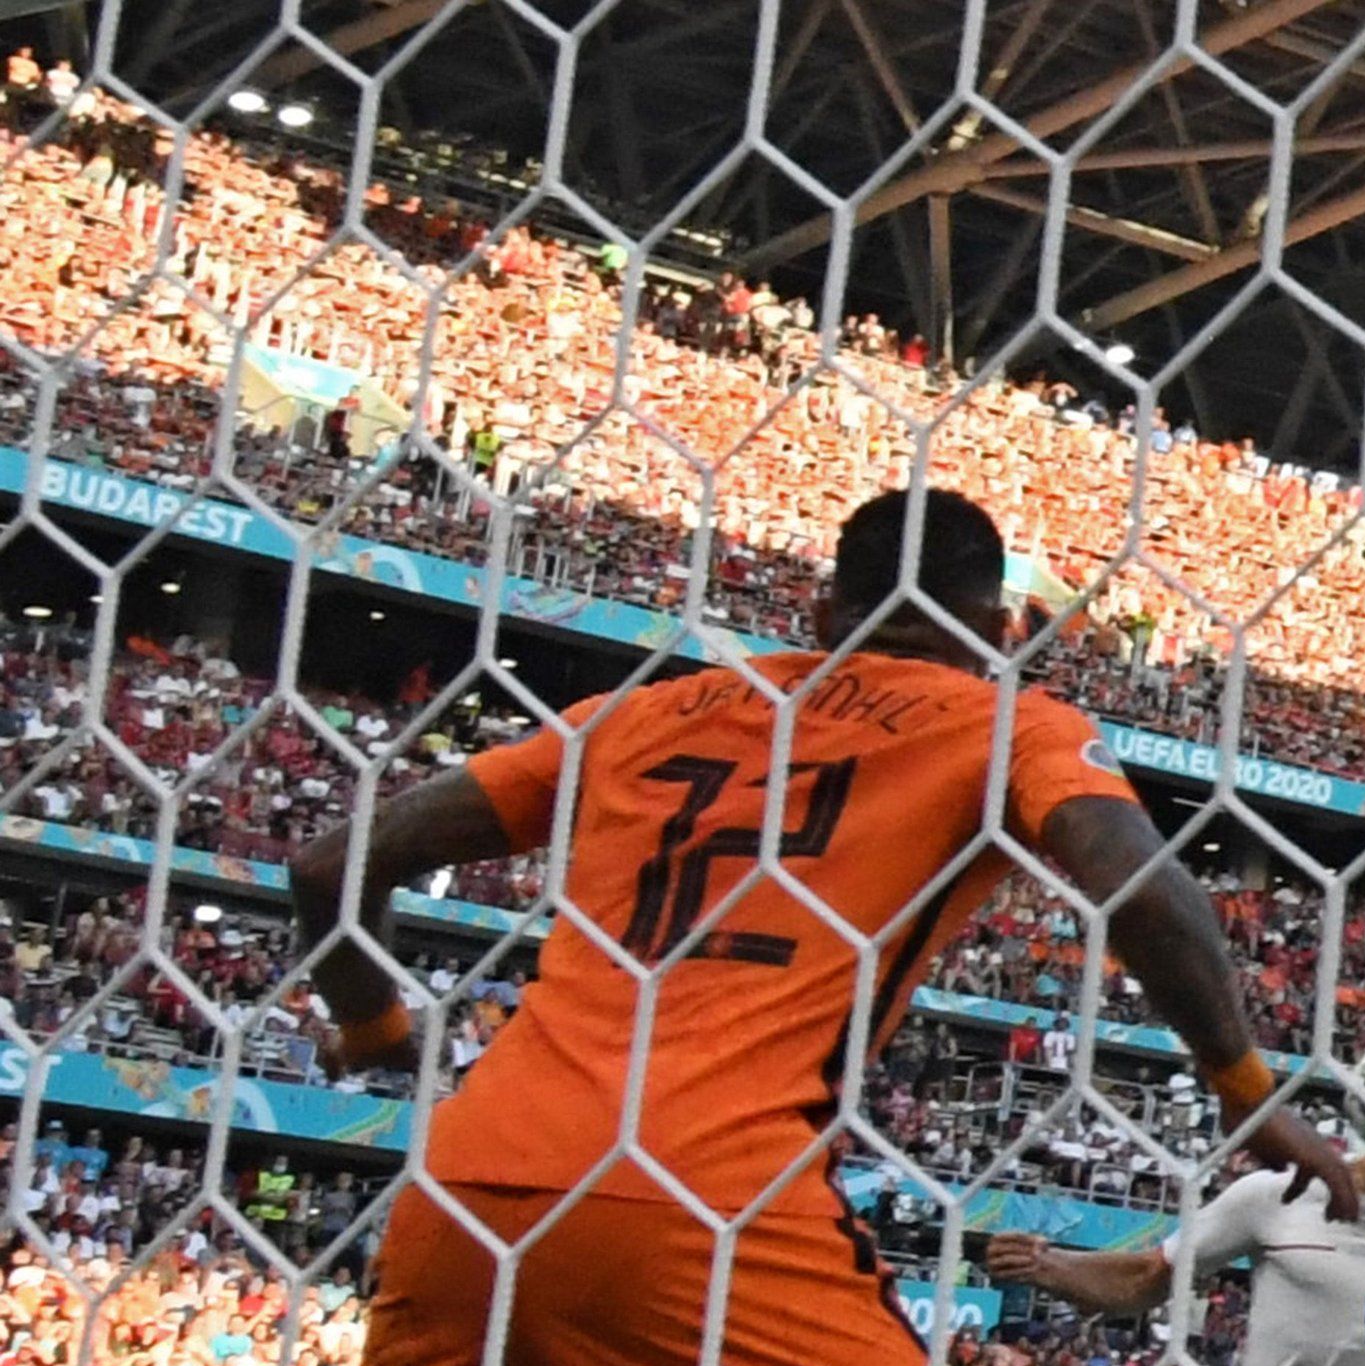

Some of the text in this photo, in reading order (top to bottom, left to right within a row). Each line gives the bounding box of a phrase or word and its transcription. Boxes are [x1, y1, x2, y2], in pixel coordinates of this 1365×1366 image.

[41, 464, 254, 543] BUDAPEST
[1113, 730, 1187, 771] UEFA
[1265, 767, 1333, 802] 2020
[613, 754, 859, 968] 12
